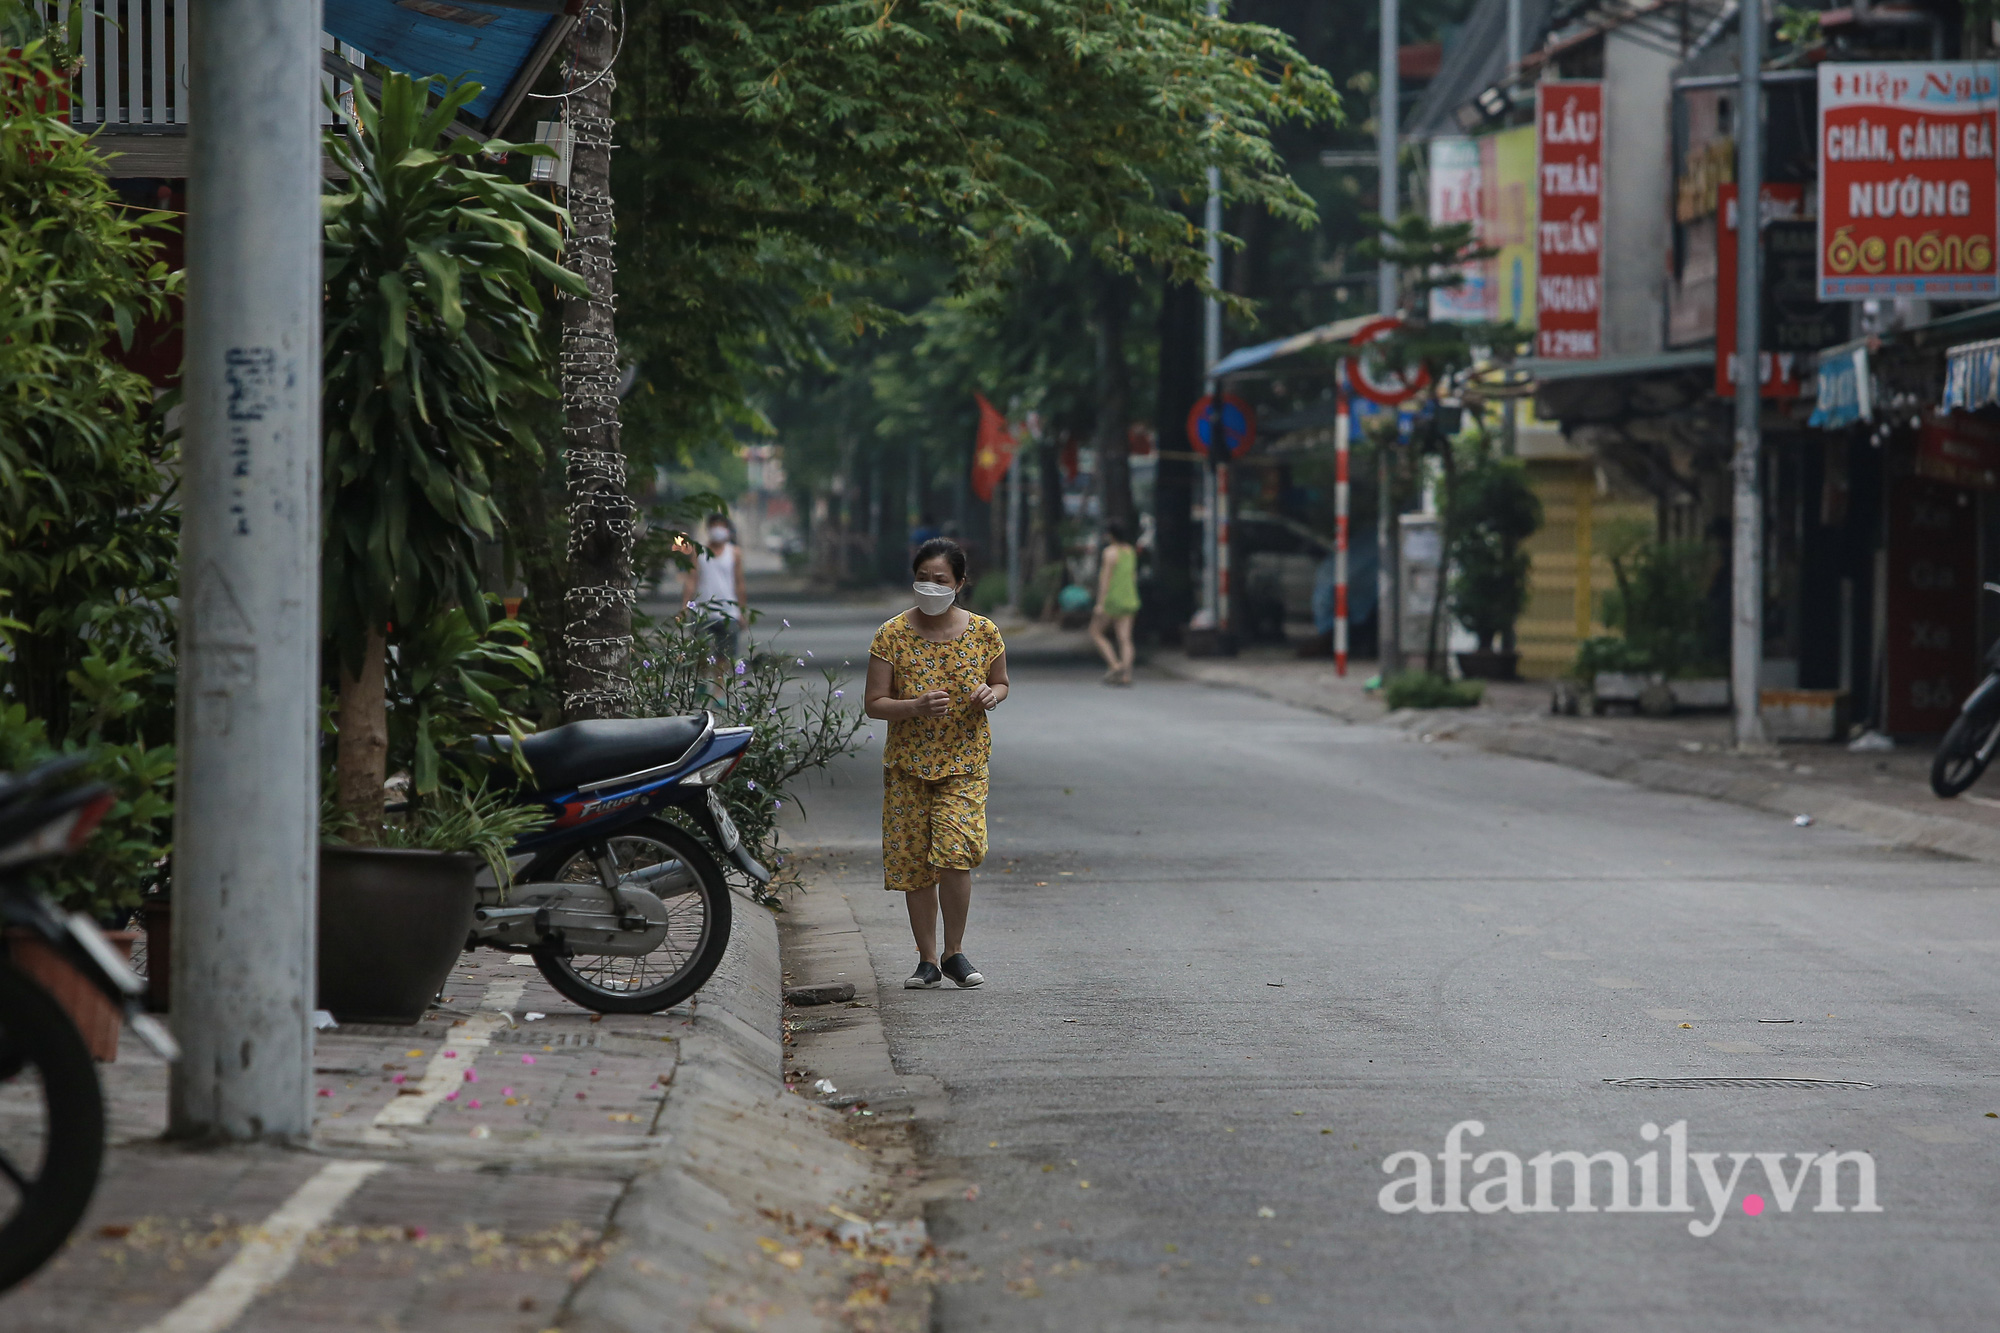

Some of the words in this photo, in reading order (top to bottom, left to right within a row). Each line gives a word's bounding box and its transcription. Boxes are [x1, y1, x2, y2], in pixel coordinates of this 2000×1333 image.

[1899, 116, 1960, 161] CÁNH
[1849, 174, 1971, 218] NƯỚNG
[580, 794, 640, 818] Future
